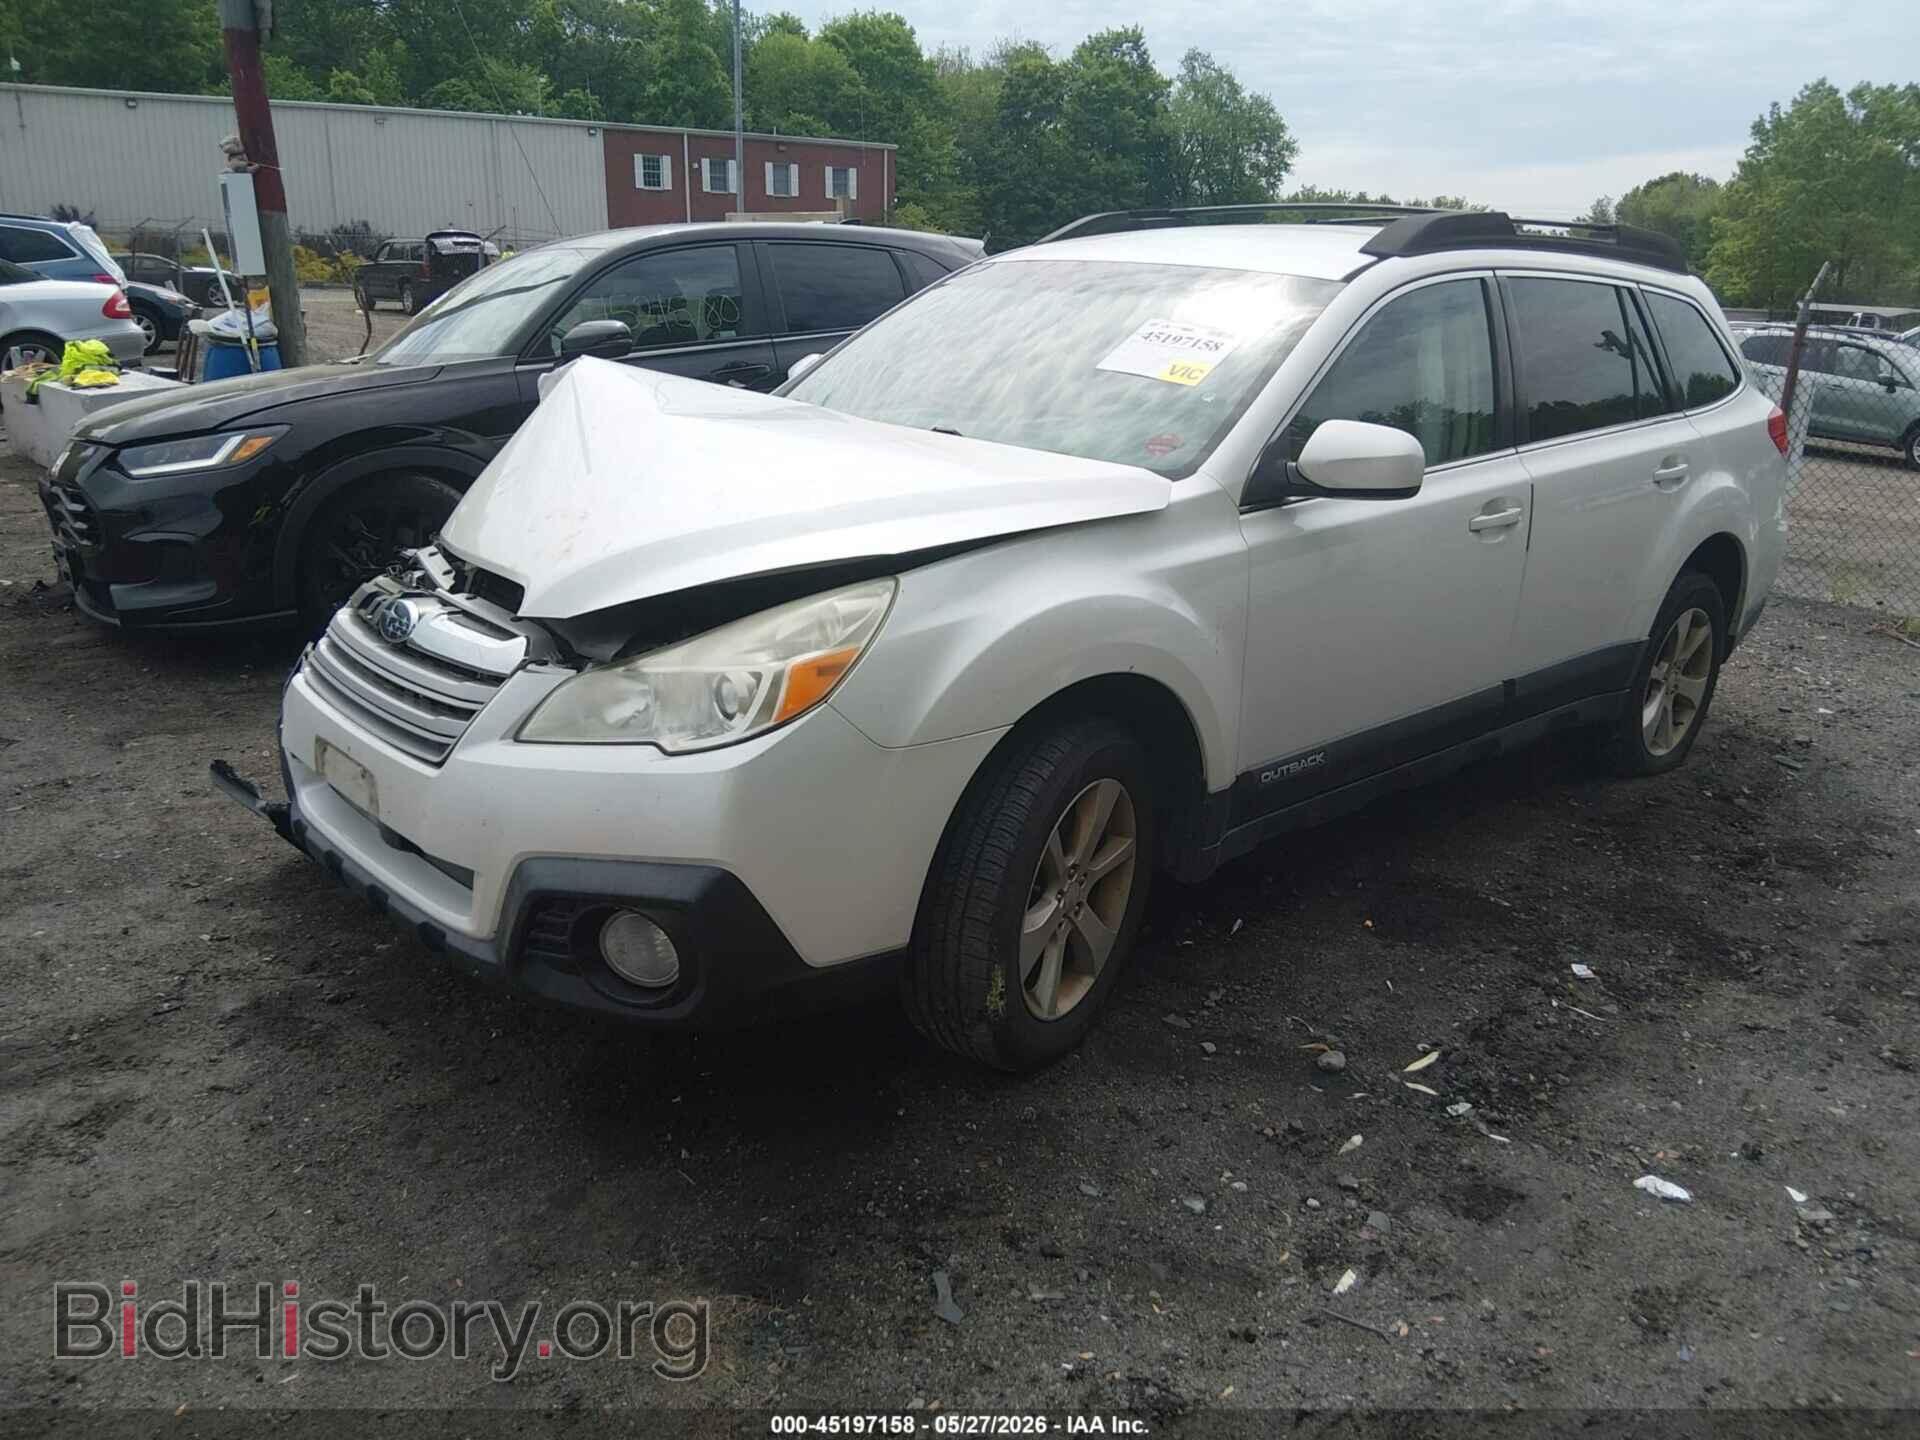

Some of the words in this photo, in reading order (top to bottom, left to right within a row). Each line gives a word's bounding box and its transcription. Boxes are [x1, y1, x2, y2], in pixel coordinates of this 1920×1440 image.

[1142, 330, 1225, 352] 45197158
[1168, 363, 1205, 381] VIC
[1260, 752, 1325, 784] OUTBACK
